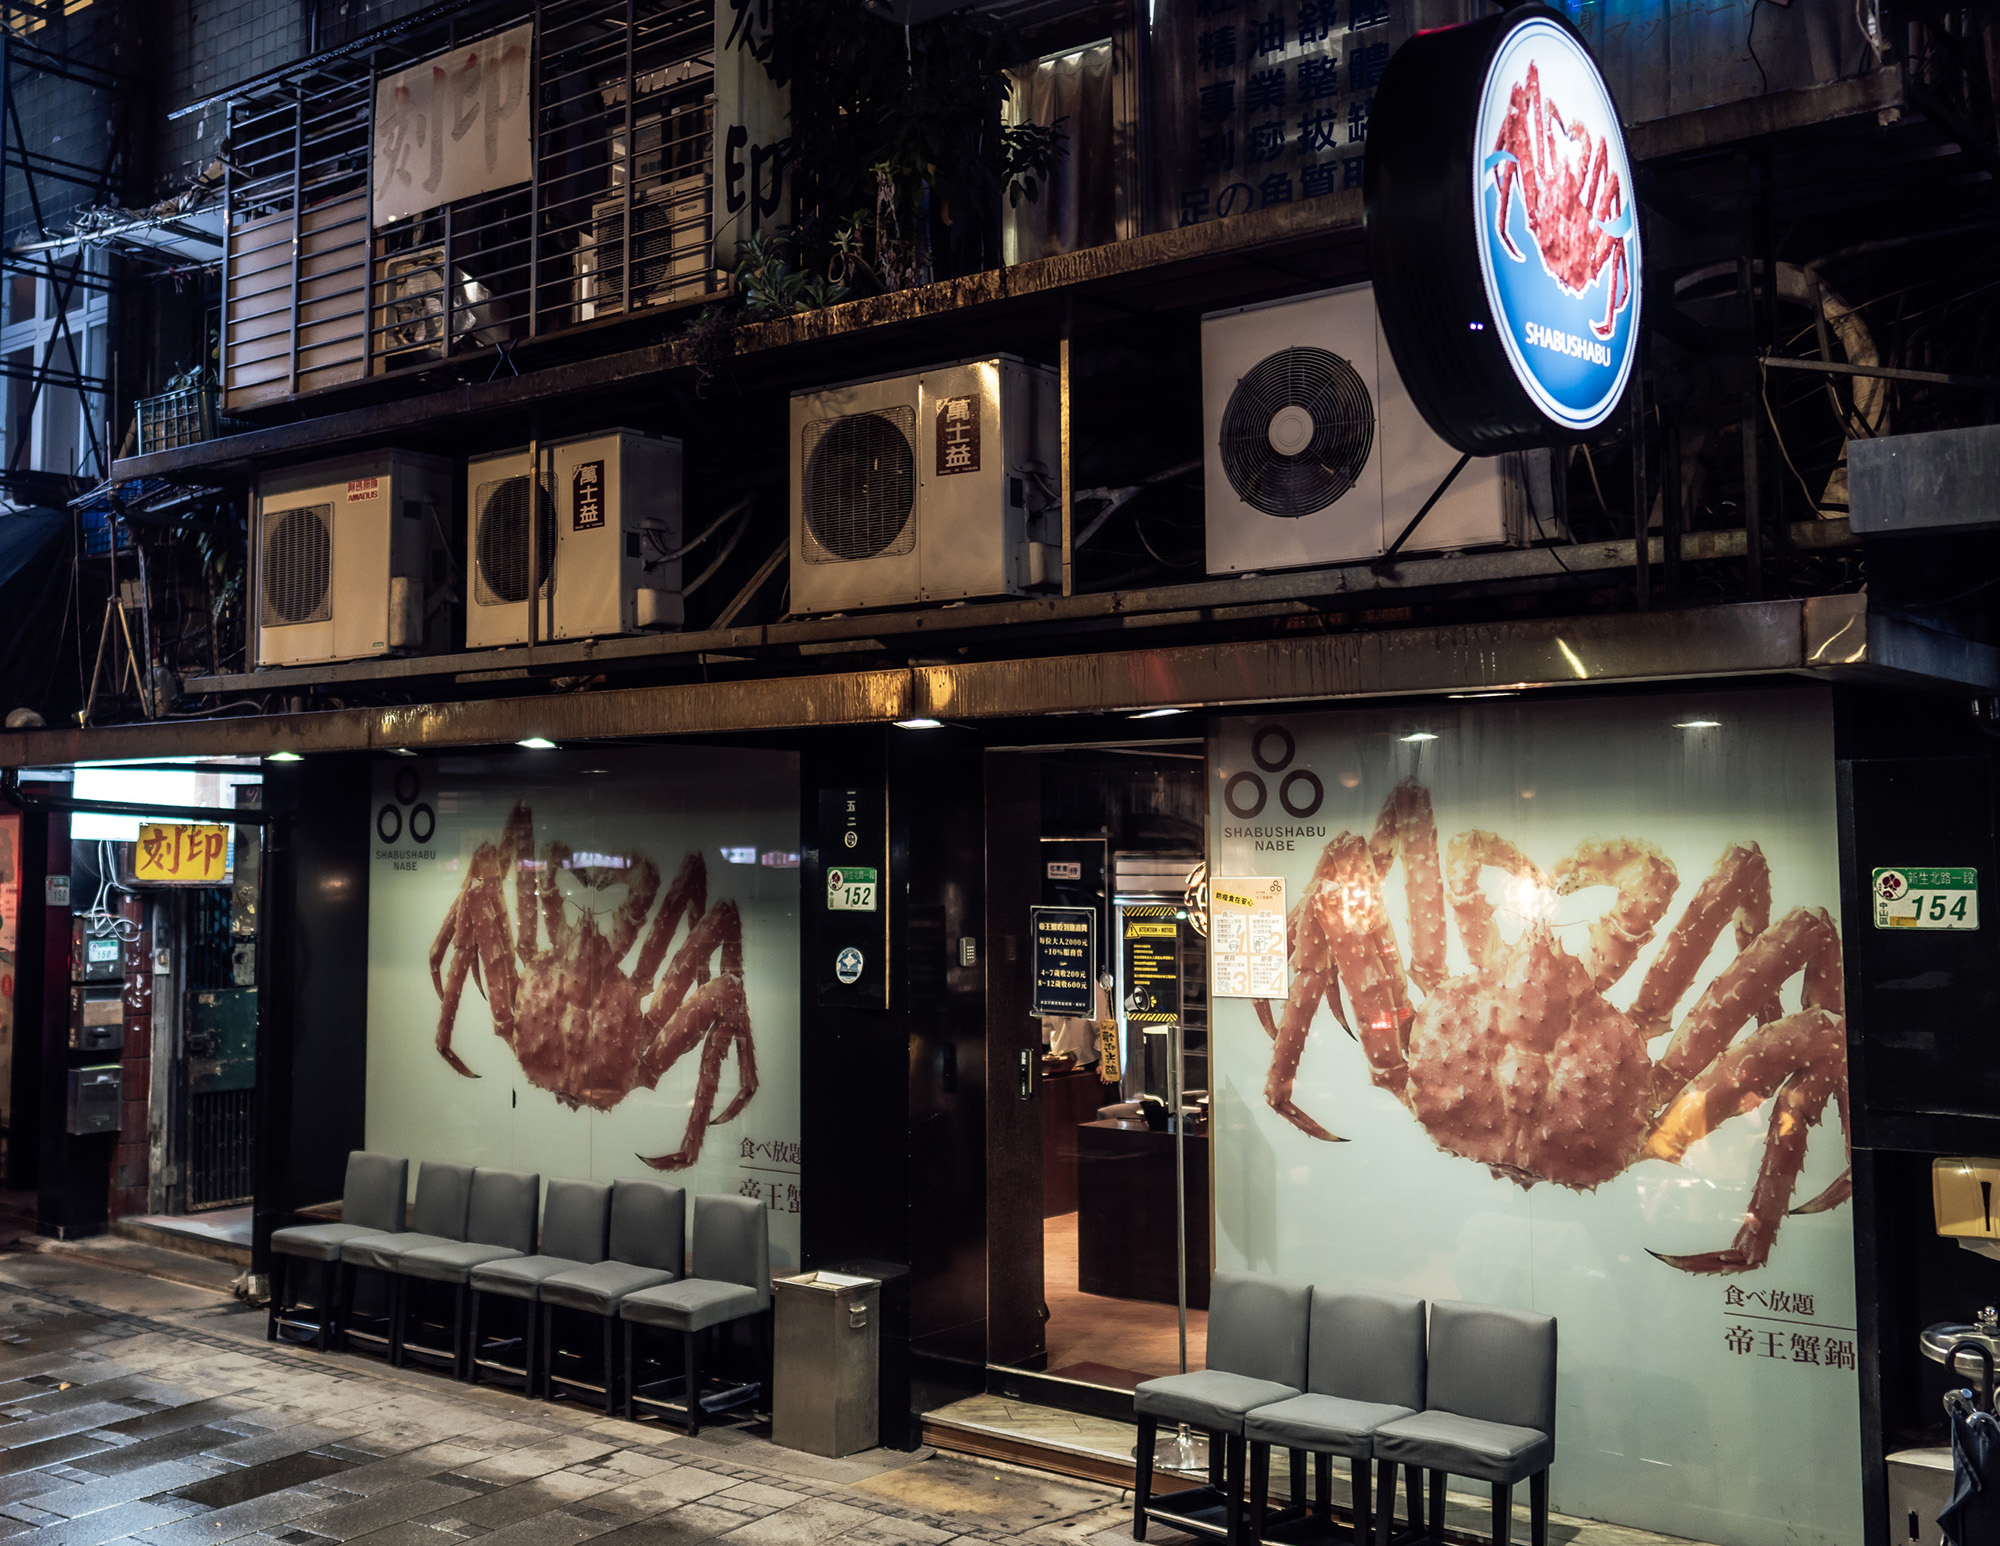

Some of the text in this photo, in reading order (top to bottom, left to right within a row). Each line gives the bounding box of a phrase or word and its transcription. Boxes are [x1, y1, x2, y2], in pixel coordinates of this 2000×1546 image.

[376, 45, 526, 201] 刻印
[1525, 322, 1610, 367] SHABUSHABU
[945, 398, 971, 467] 萬士益
[579, 464, 599, 523] 萬士益
[1224, 826, 1326, 838] SHABUSHABU
[141, 826, 223, 877] 刻印
[375, 850, 436, 860] SHABUSHABU
[1255, 840, 1295, 851] NABE
[393, 862, 417, 871] NABE
[1908, 872, 1975, 885] 新生北路一段
[54, 890, 67, 902] 150
[845, 887, 871, 905] 152
[1216, 892, 1254, 907] 防疫食在安心
[1912, 895, 1967, 921] 154
[1879, 902, 1888, 925] 中山區
[1102, 1031, 1118, 1076] 歡迎光臨
[1724, 1284, 1815, 1316] 食べ放題
[1724, 1325, 1856, 1371] 帝王蟹鍋
